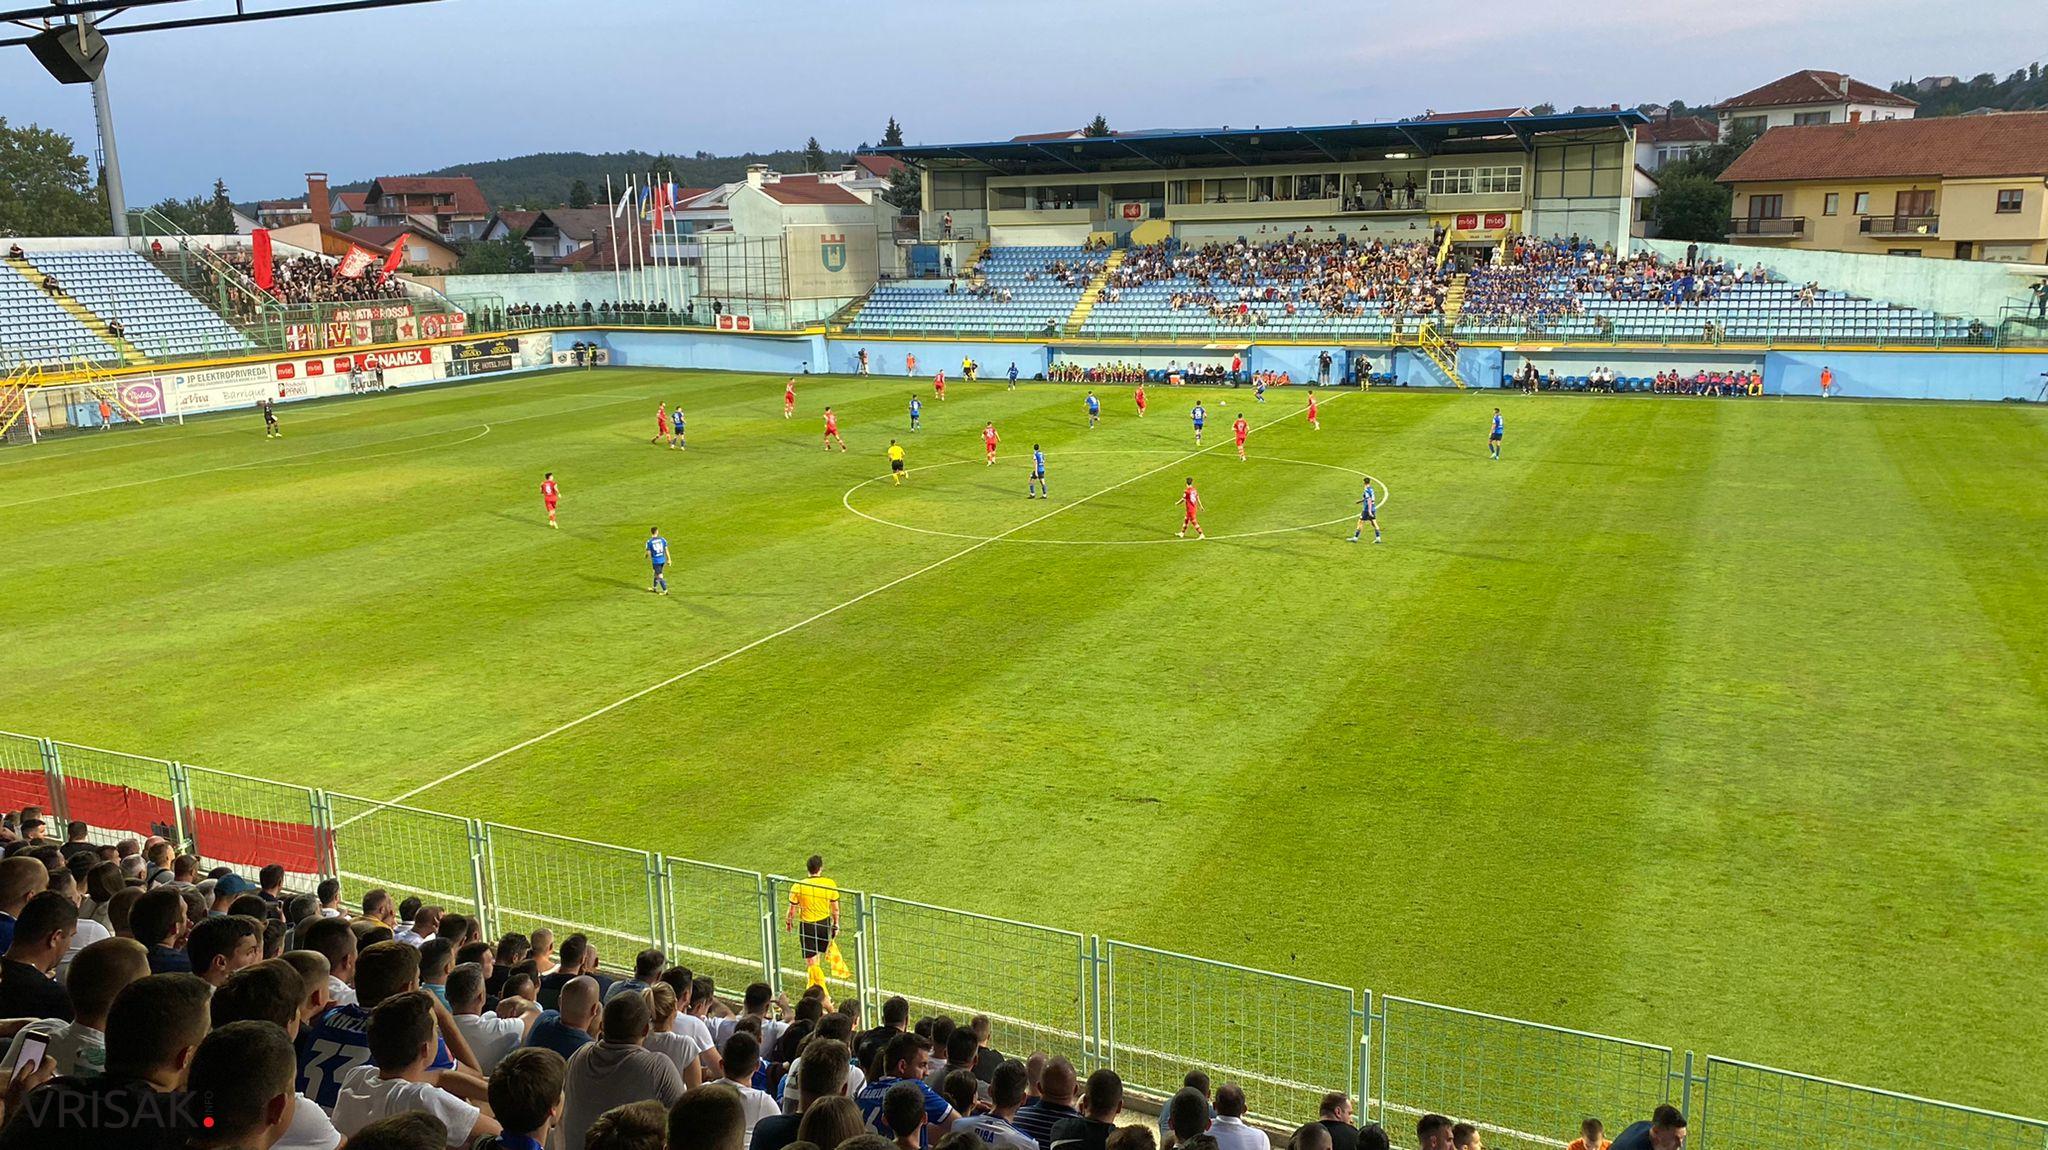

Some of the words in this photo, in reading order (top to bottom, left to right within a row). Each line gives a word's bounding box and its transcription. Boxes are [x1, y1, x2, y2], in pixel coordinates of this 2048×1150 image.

[336, 308, 373, 321] ARATA
[380, 306, 410, 319] ROSSA
[329, 322, 349, 346] V
[378, 351, 423, 368] NAMEX
[187, 374, 196, 384] JP
[197, 367, 267, 382] ELEKTROPRIVREDA
[222, 388, 266, 400] Barrique
